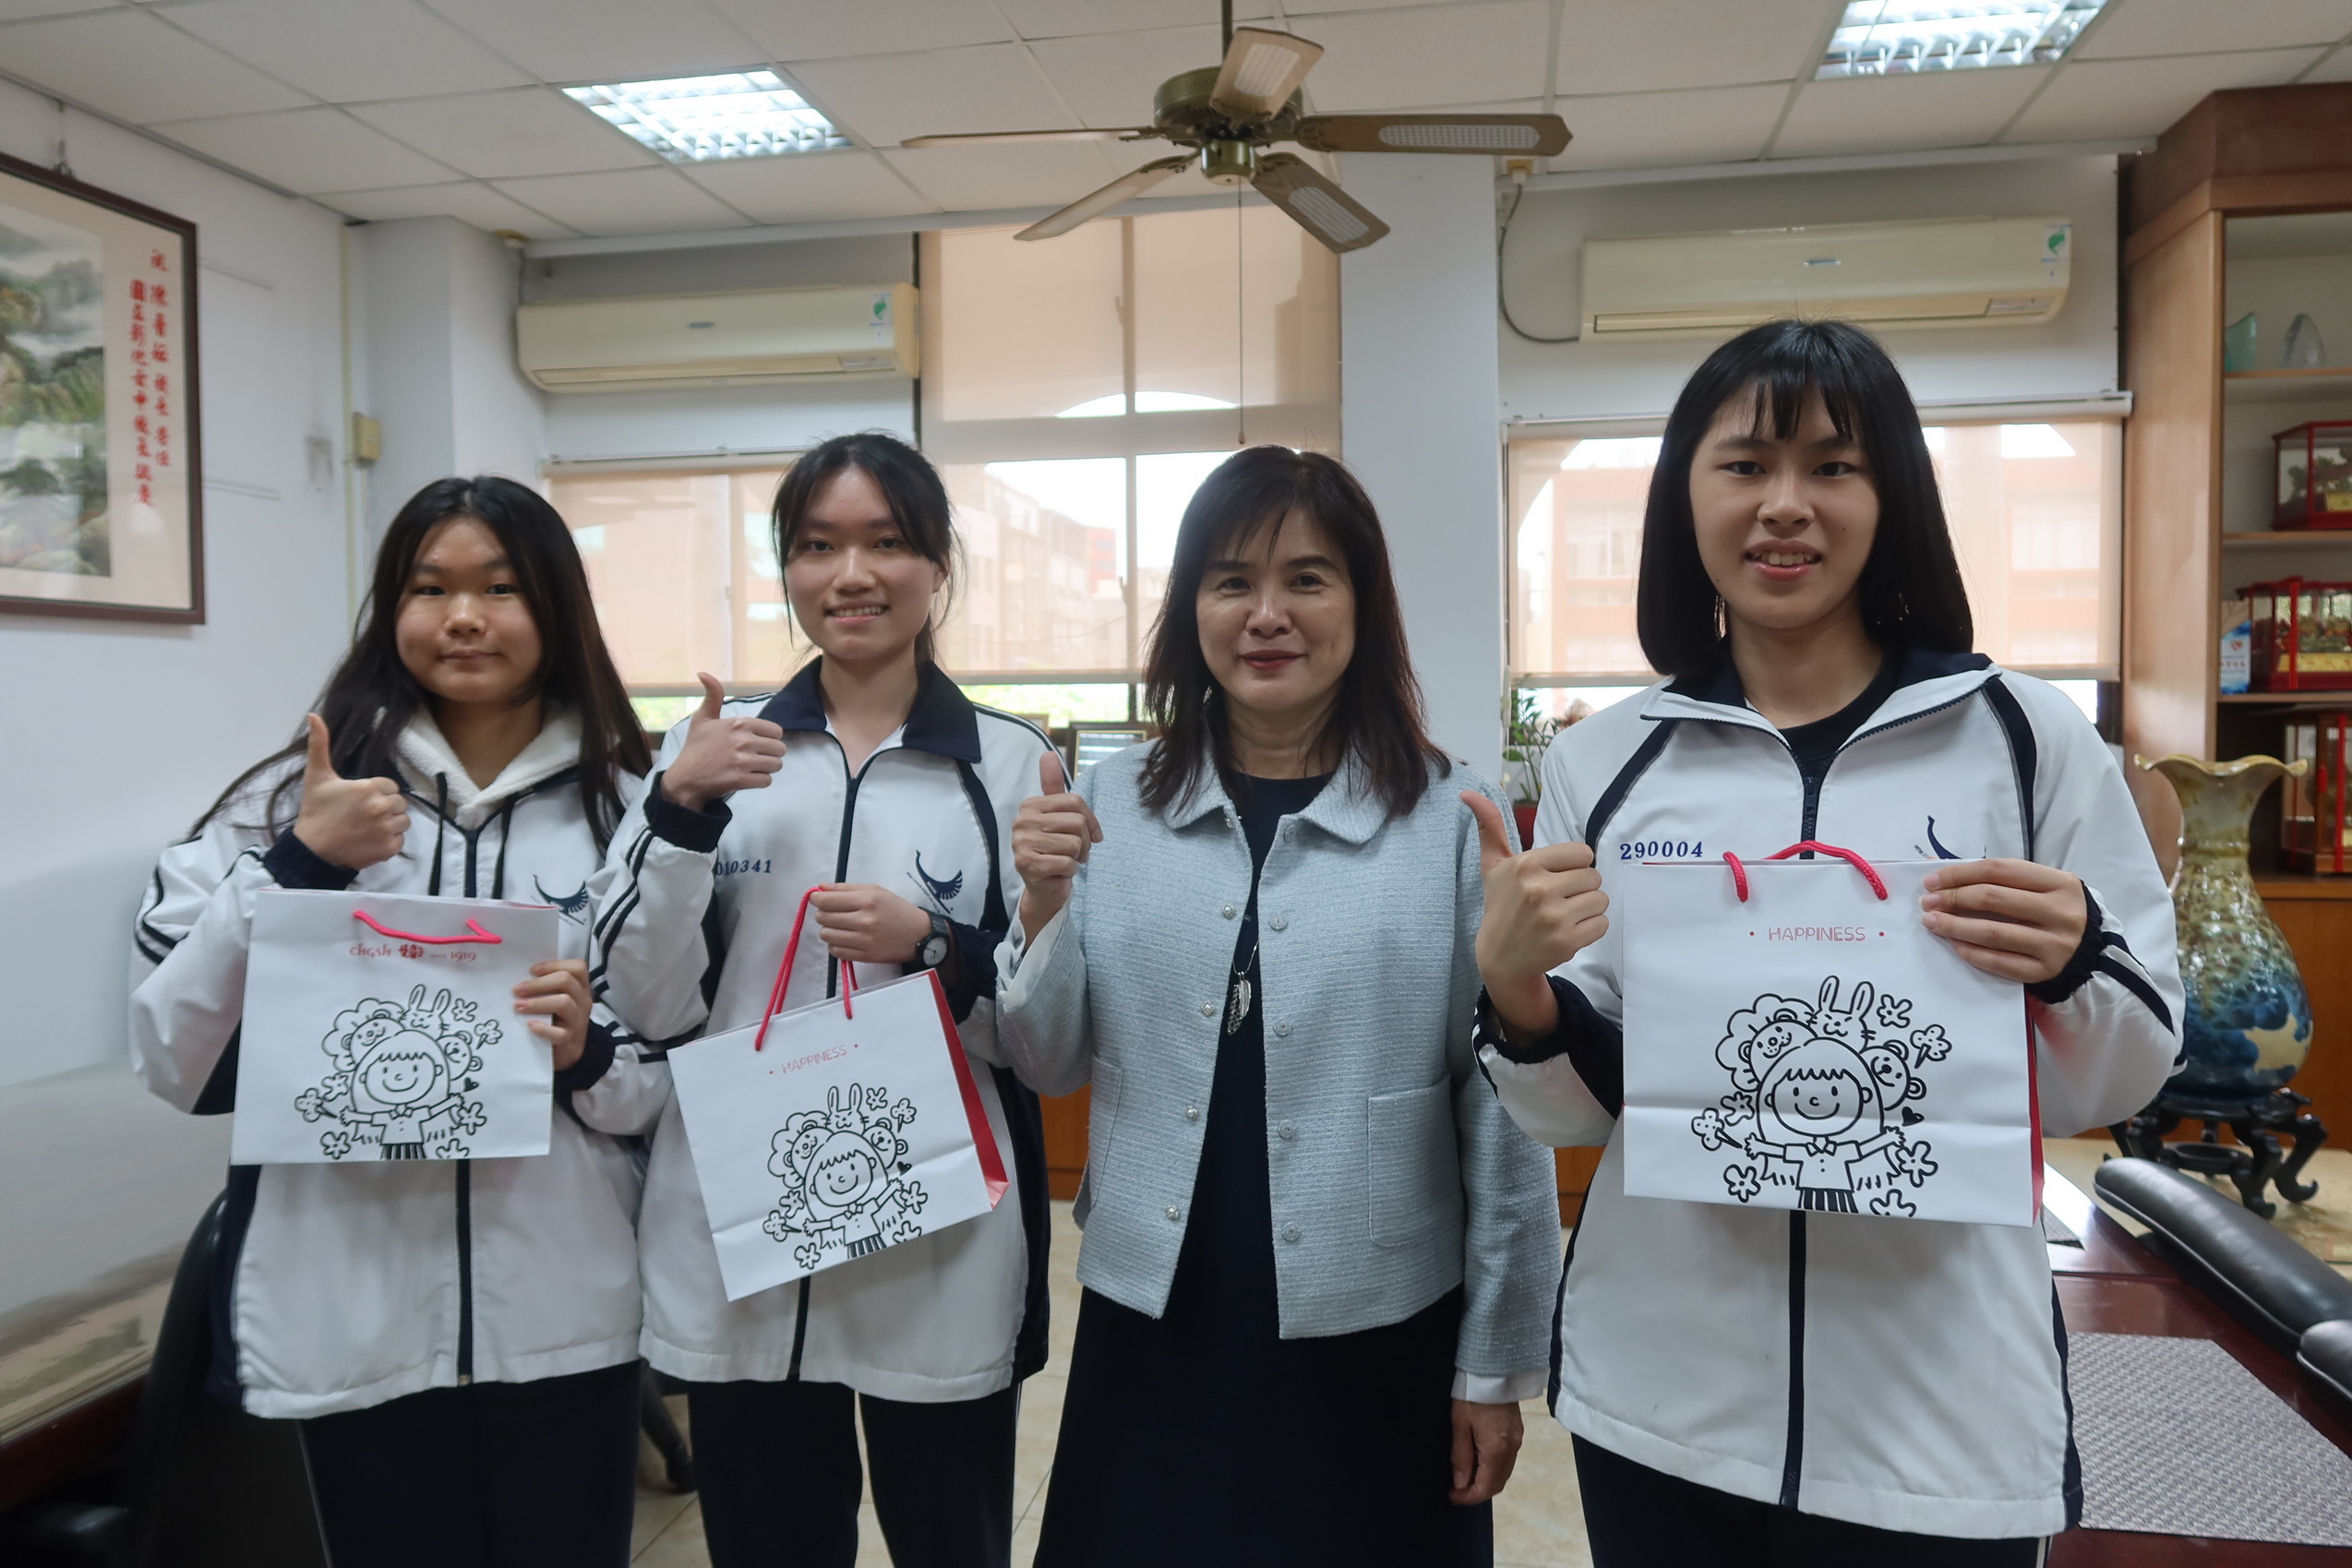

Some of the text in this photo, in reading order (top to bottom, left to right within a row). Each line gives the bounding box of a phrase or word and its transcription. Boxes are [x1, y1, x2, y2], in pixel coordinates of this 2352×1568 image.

[1619, 841, 1703, 860] 290004
[1768, 926, 1866, 942] HAPPINESS
[450, 951, 476, 962] 1919
[781, 1044, 847, 1074] HAPPINESS
